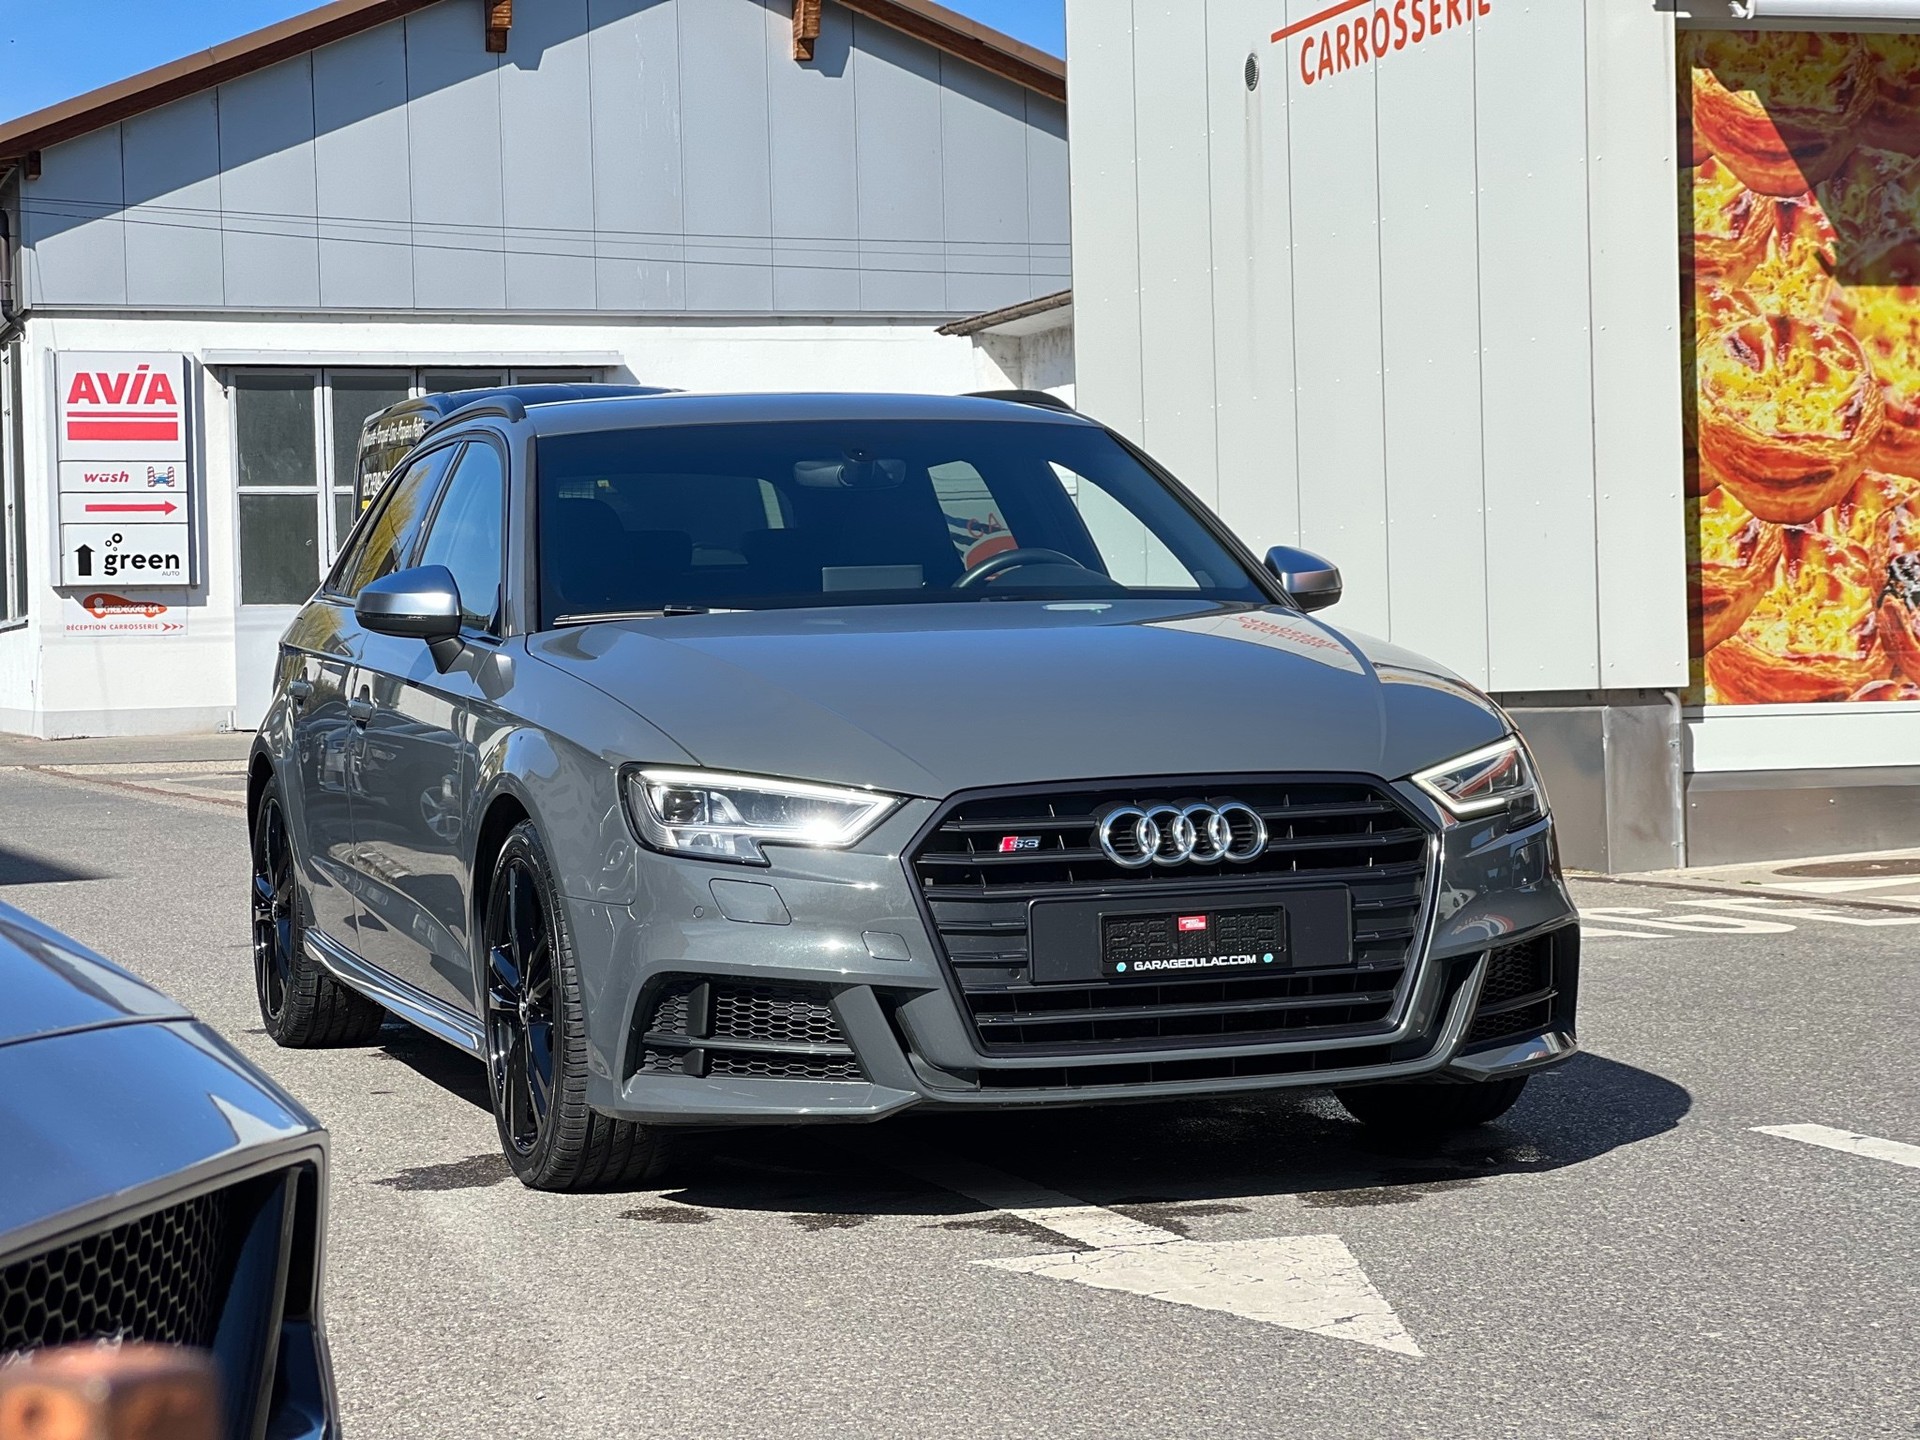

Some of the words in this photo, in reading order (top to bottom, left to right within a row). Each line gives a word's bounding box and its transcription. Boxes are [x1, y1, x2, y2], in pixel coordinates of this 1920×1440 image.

[84, 470, 129, 483] wash
[104, 554, 180, 576] green
[109, 623, 159, 631] CARROSSERIE
[1133, 954, 1257, 971] GARAGEDULAC.COM
